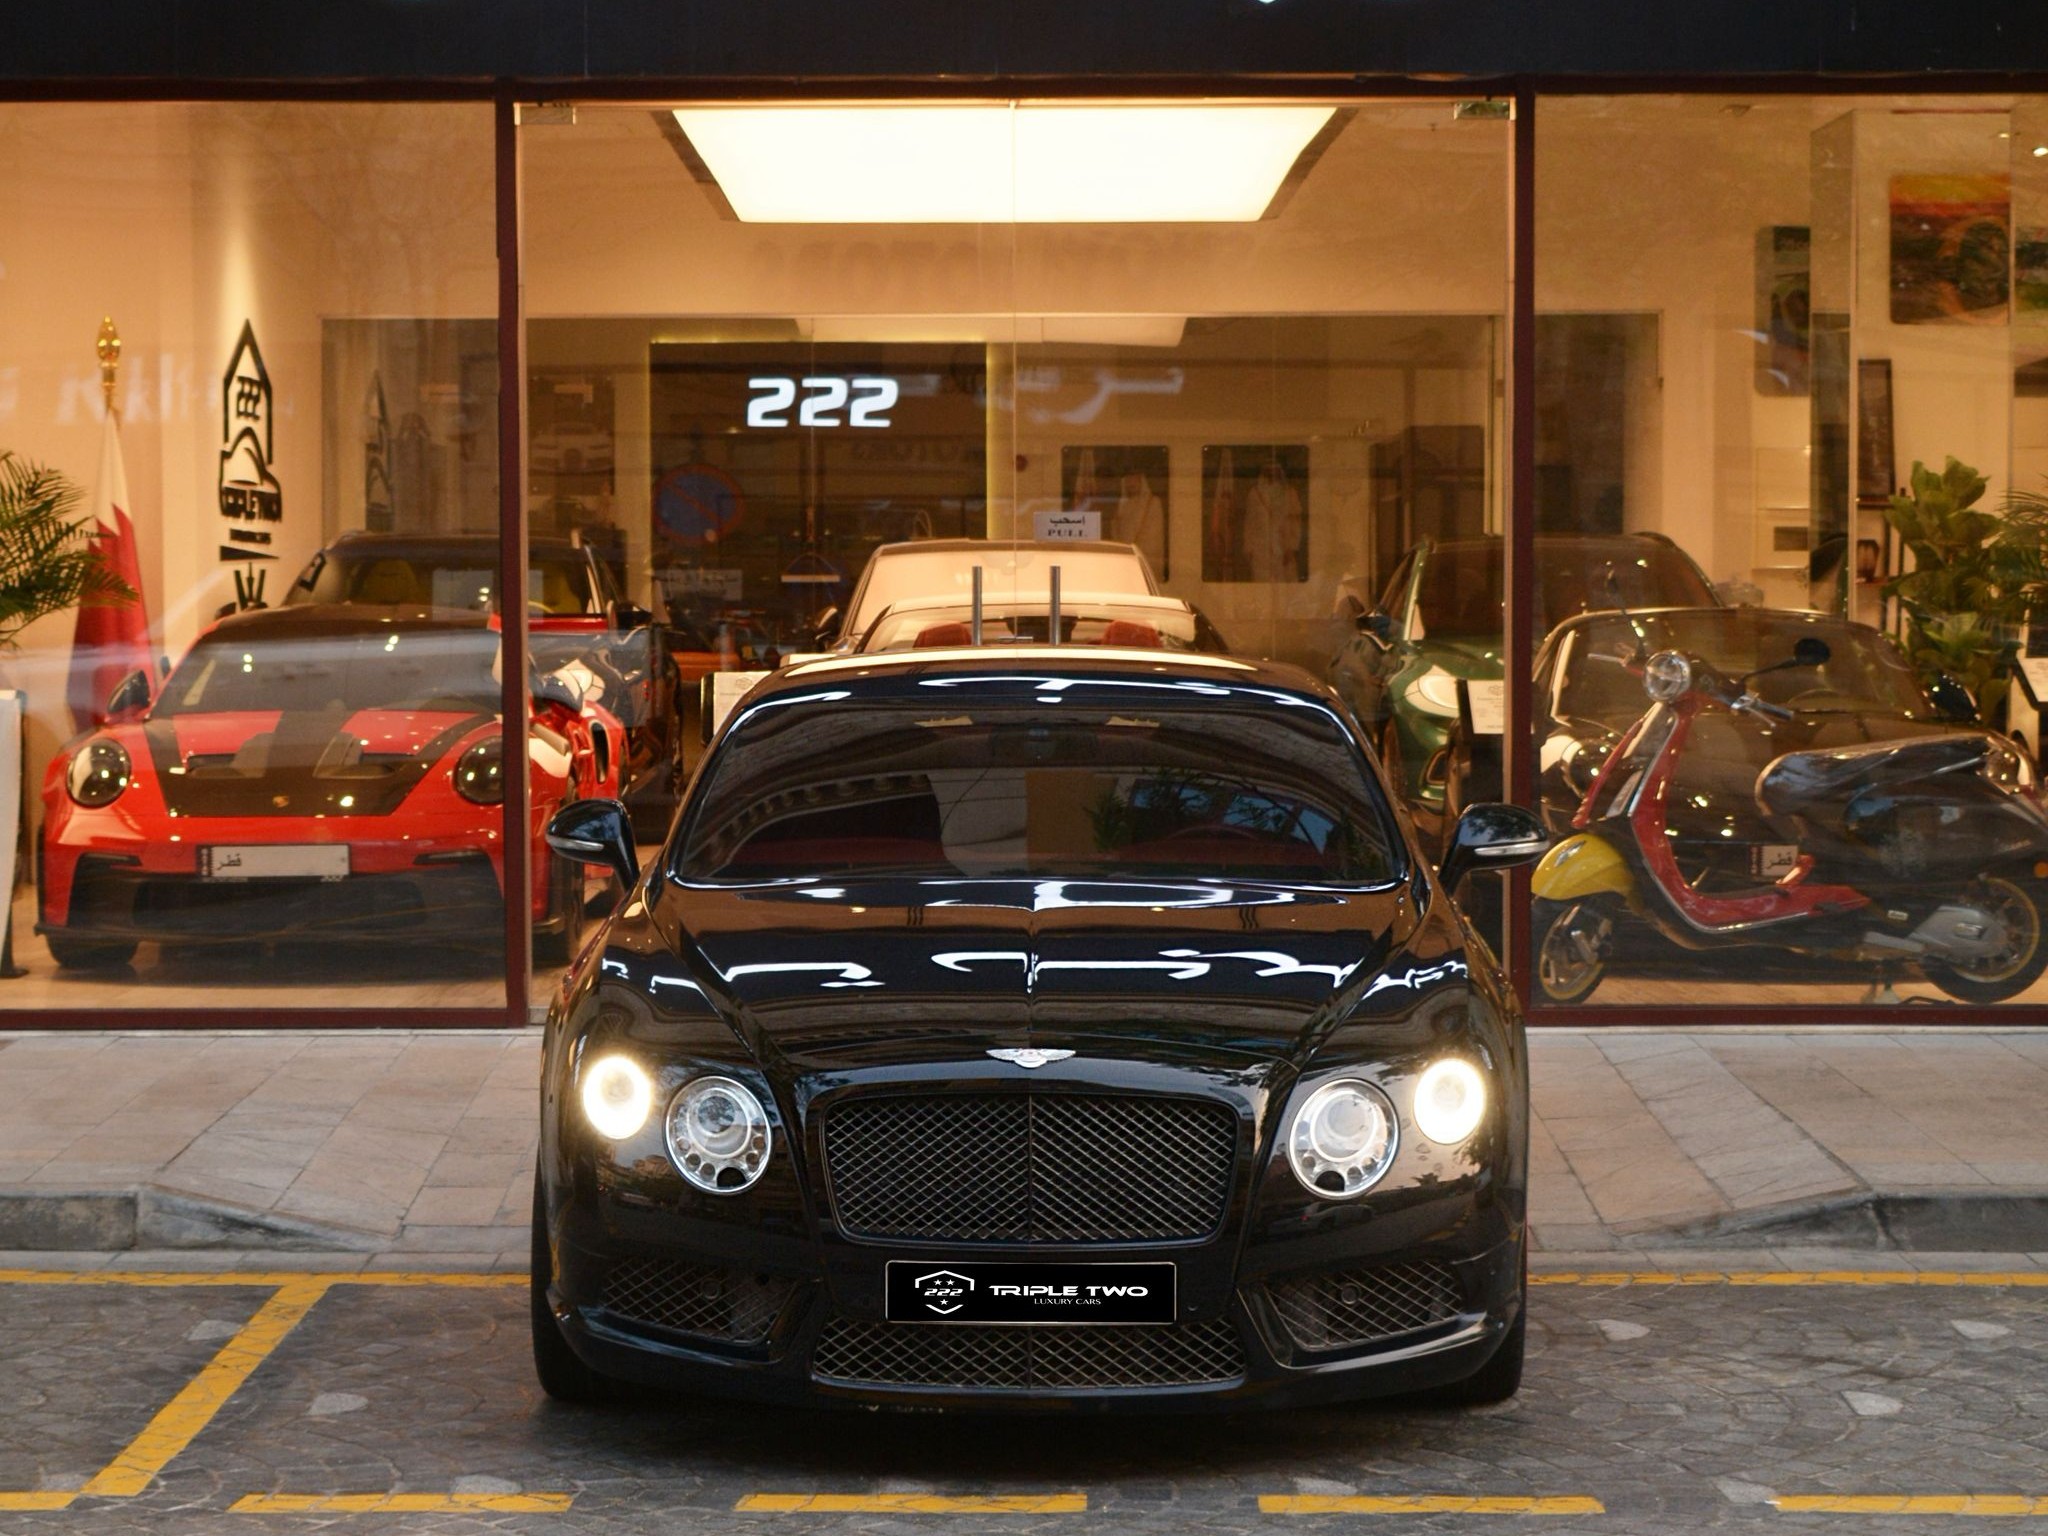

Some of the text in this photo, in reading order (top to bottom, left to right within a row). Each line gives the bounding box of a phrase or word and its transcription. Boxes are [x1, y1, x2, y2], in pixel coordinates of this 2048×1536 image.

[747, 377, 899, 428] 222
[1047, 529, 1088, 537] PULL
[217, 853, 242, 871] قطر
[1766, 851, 1792, 870] قطر
[924, 1288, 963, 1297] 222
[989, 1285, 1149, 1297] TRIPLE TWO
